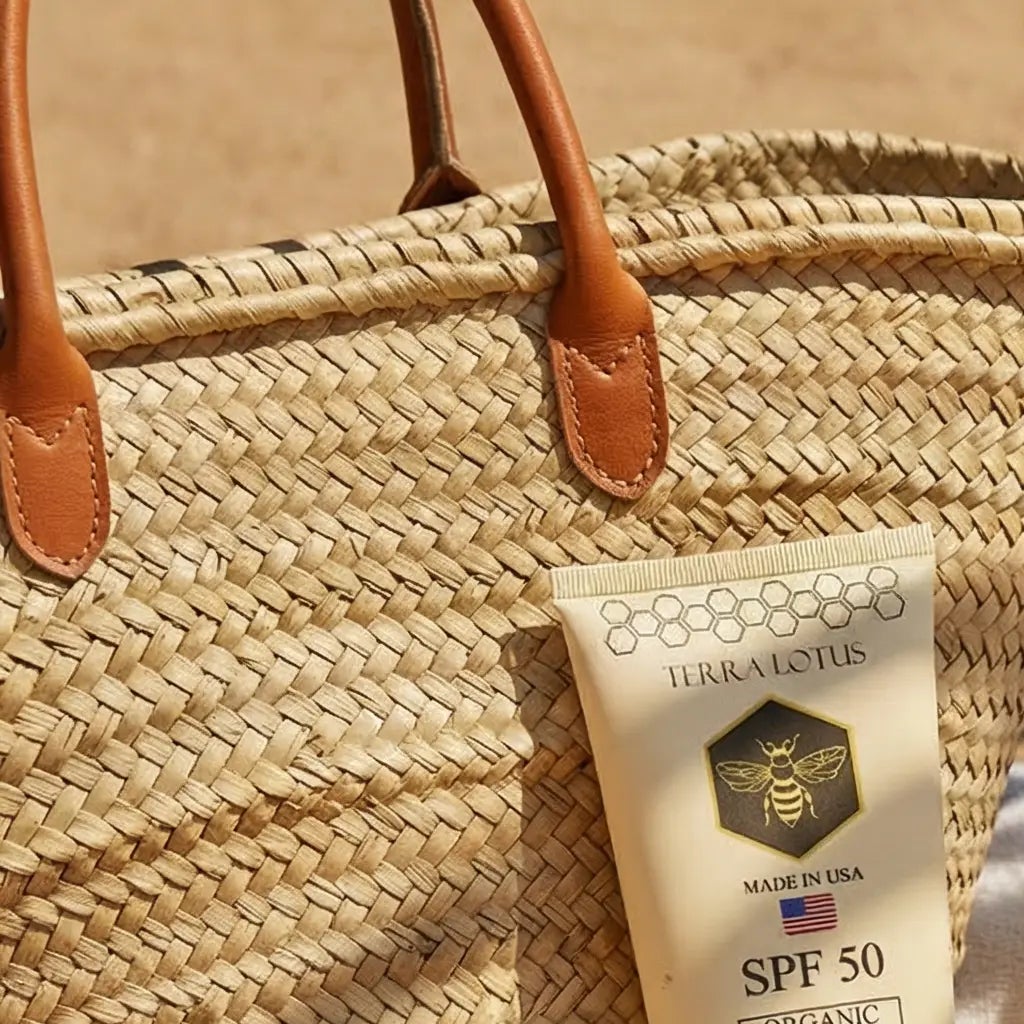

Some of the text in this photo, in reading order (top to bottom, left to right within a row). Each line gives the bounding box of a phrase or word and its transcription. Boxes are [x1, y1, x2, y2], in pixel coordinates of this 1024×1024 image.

[663, 642, 867, 687] TERRA LOTUS
[744, 866, 864, 895] MADE IN USA
[741, 942, 885, 997] SPF 50
